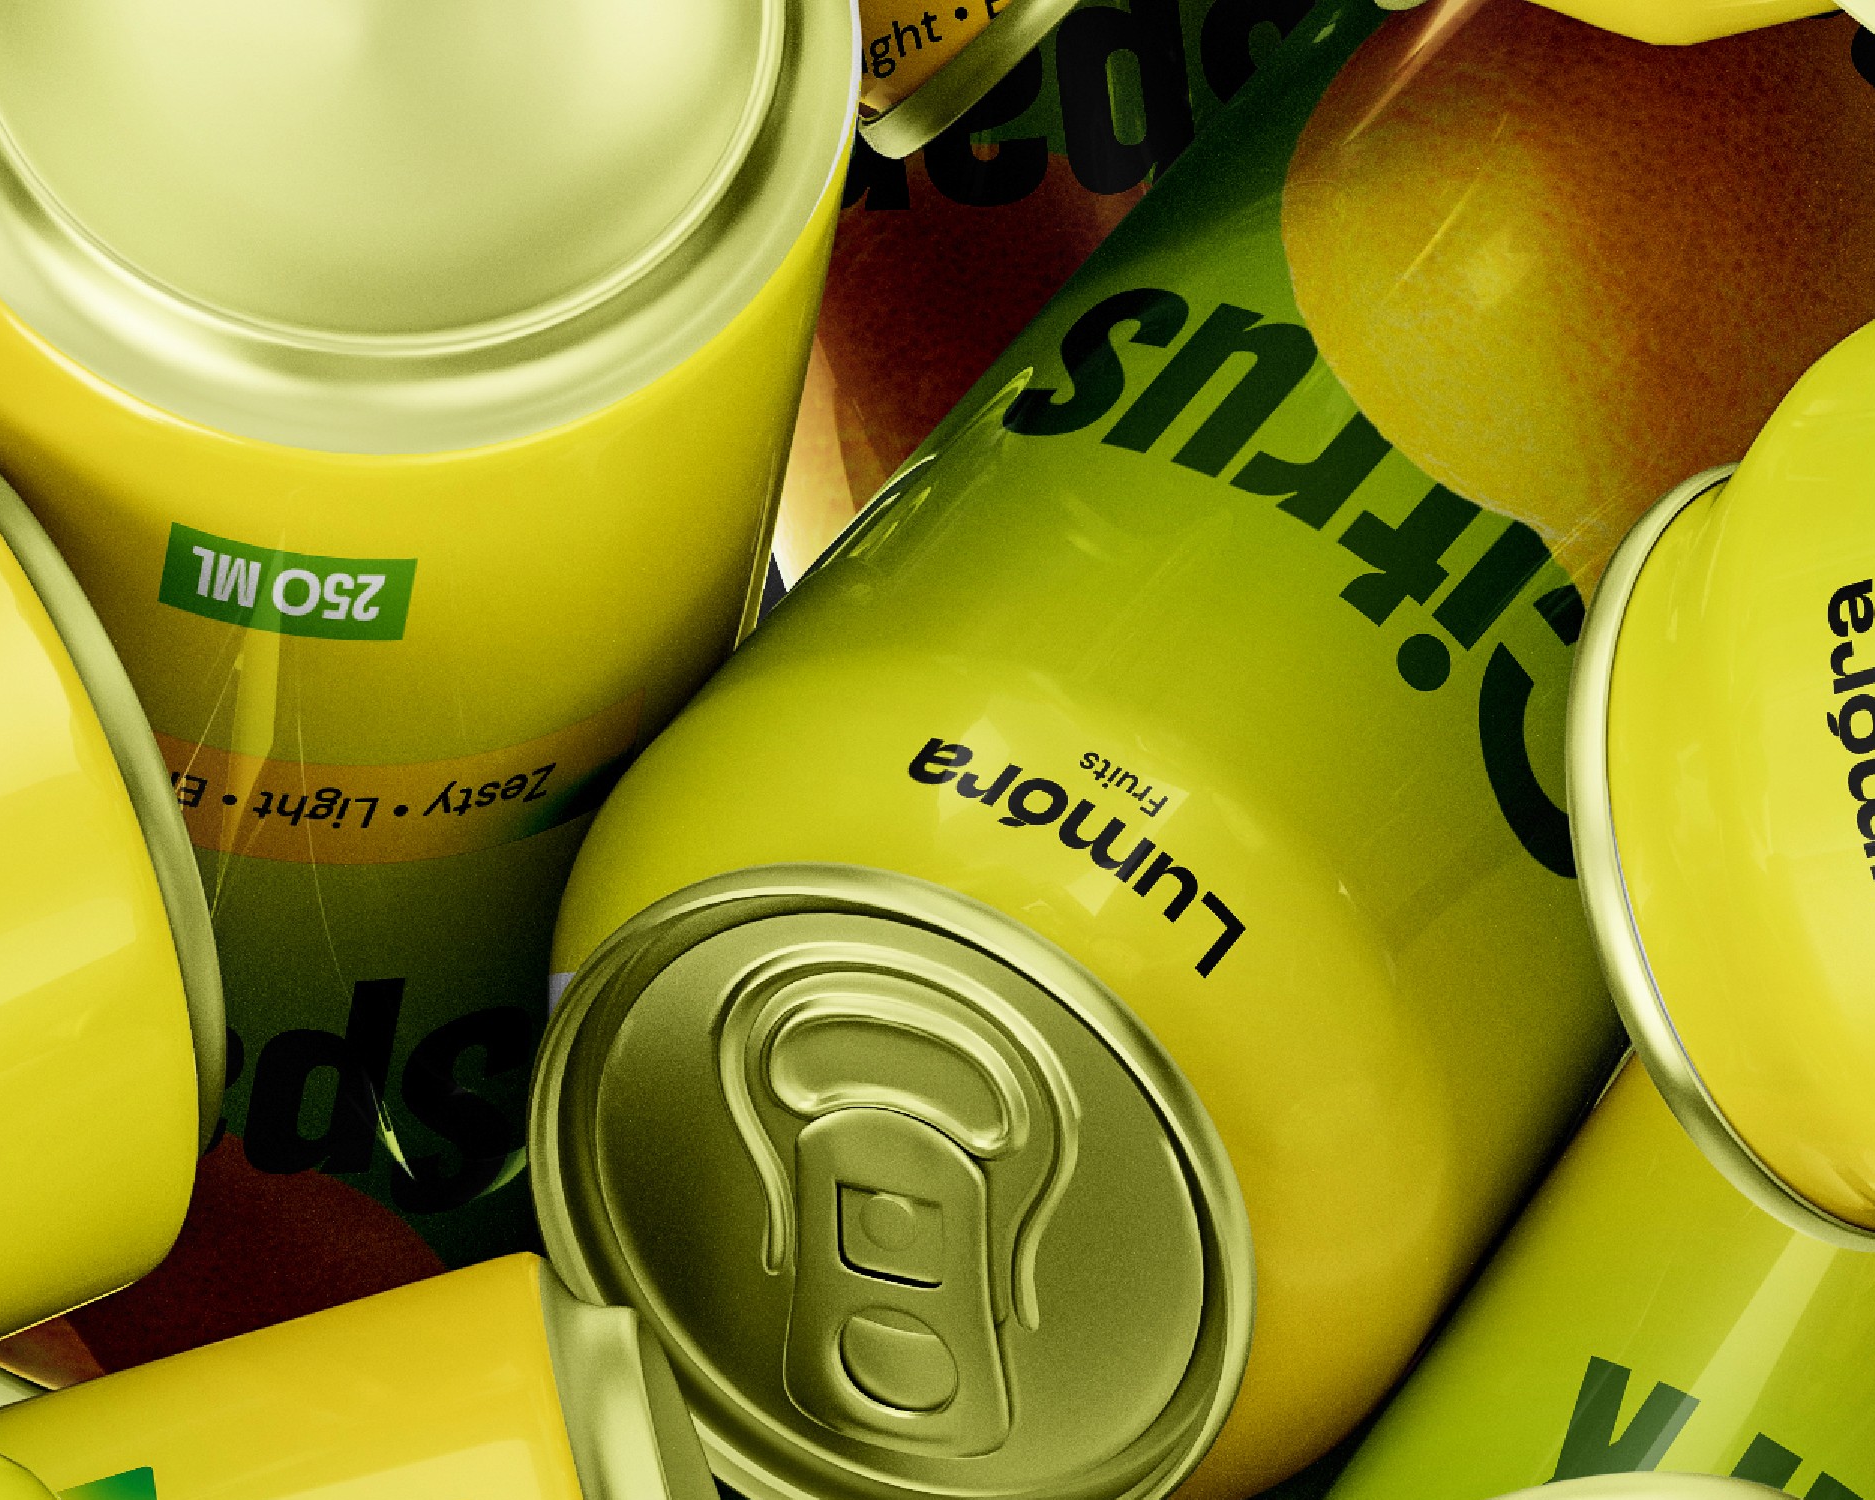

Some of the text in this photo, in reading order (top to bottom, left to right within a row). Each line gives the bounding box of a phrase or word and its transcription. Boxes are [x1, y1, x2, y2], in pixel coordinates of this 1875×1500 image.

[862, 11, 942, 78] ght
[191, 547, 386, 621] 250 ML
[250, 784, 377, 833] Light
[423, 765, 558, 827] Zesty
[1079, 748, 1168, 818] Fruits
[907, 734, 1246, 976] Lumóra
